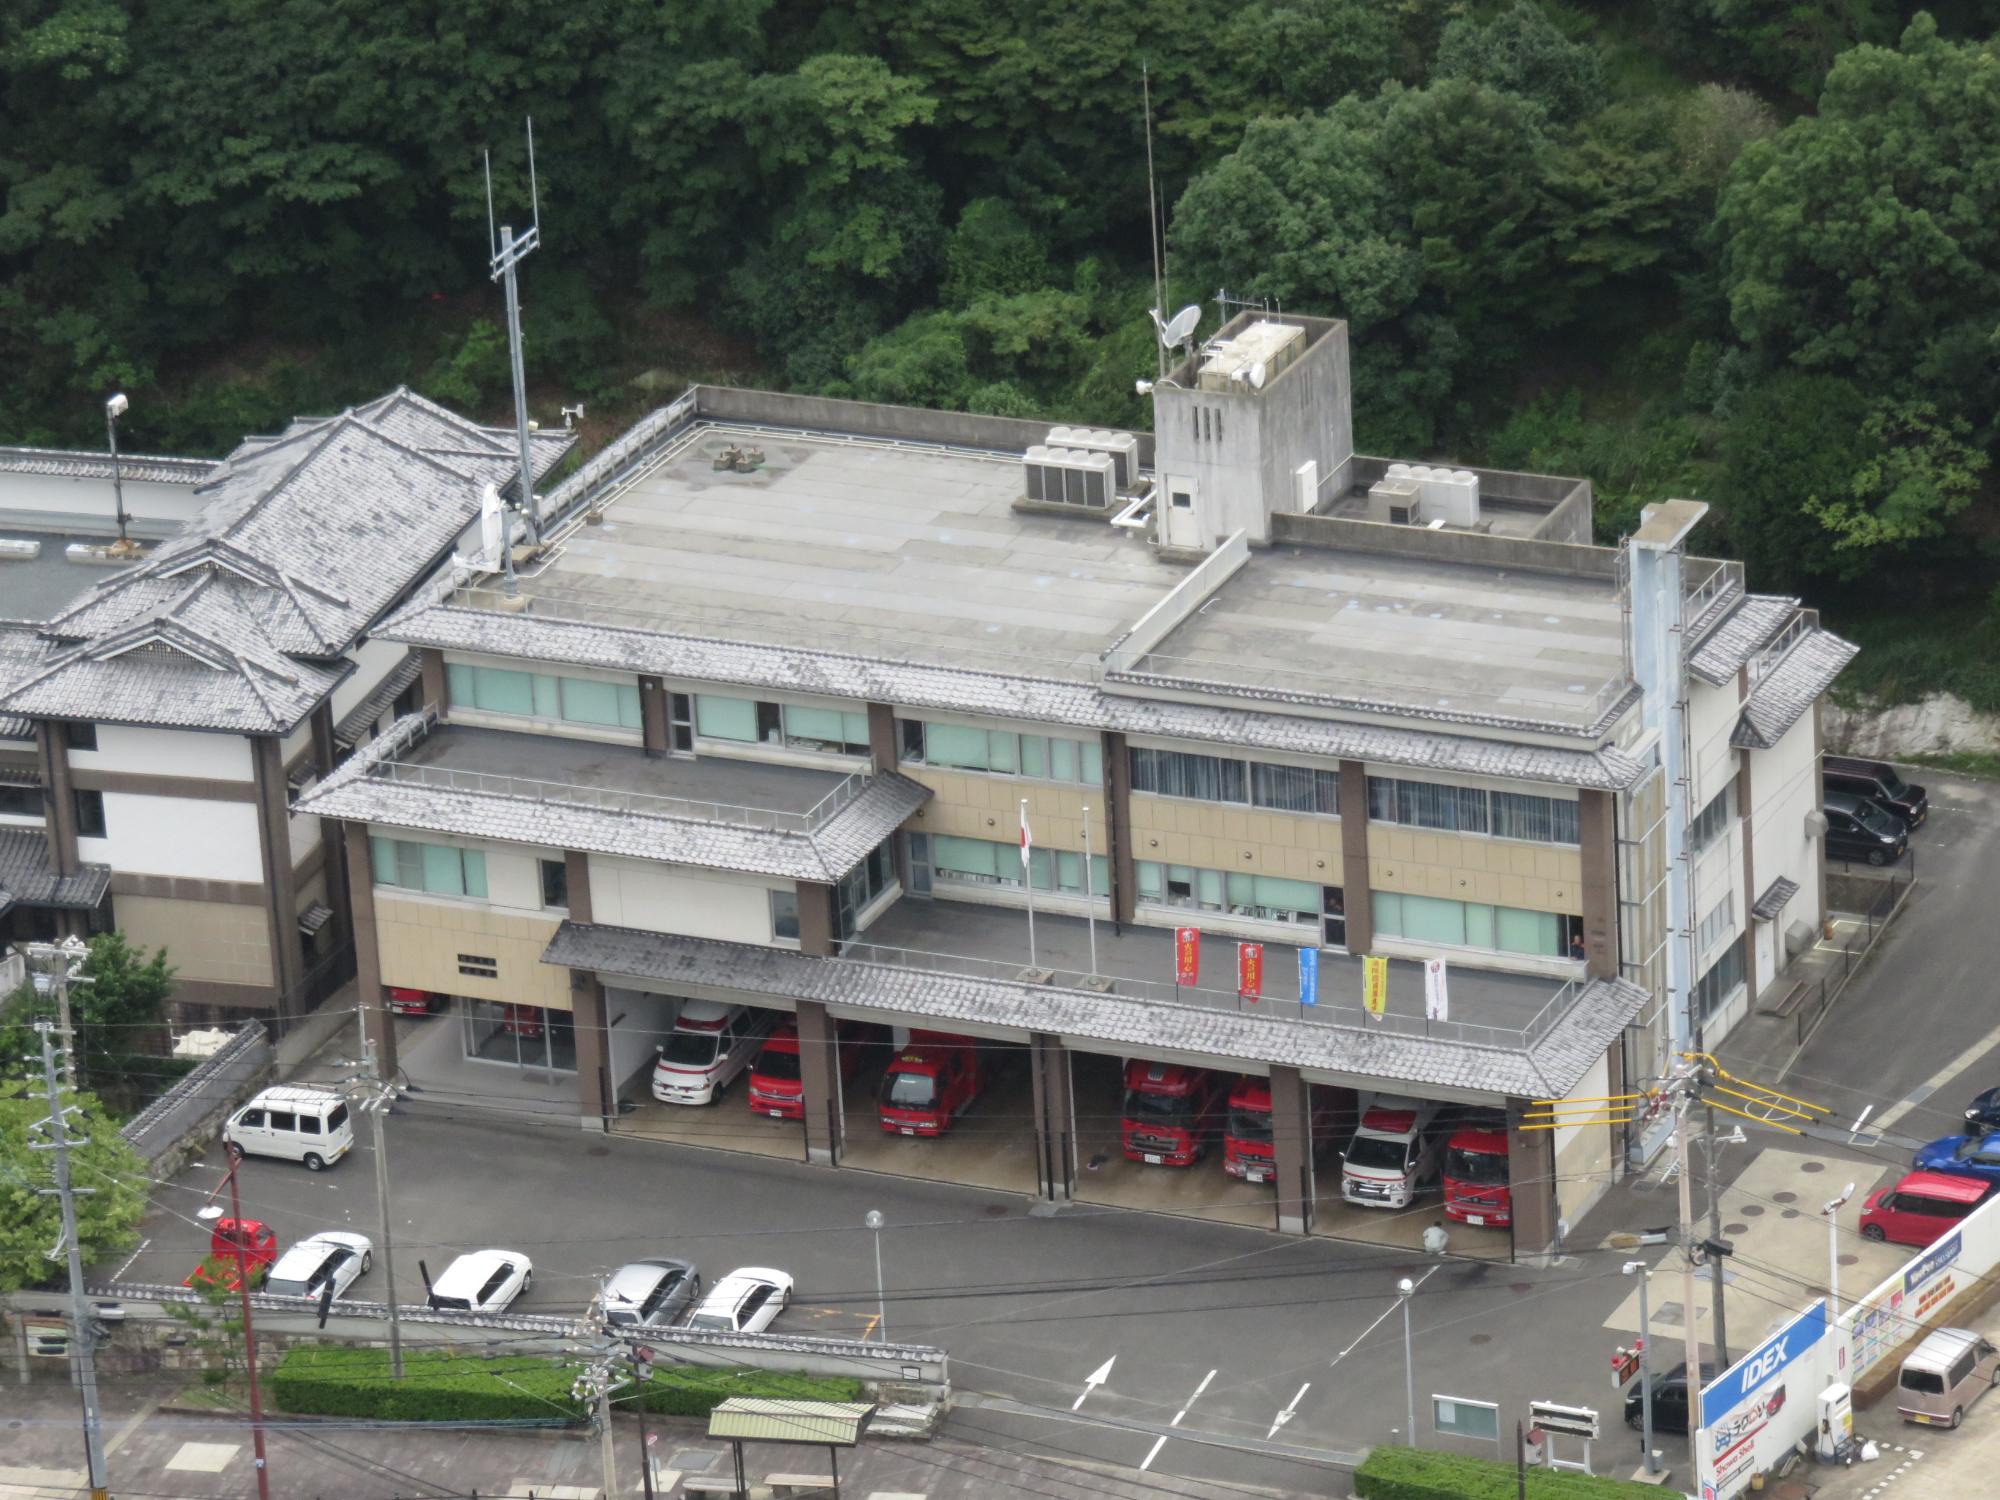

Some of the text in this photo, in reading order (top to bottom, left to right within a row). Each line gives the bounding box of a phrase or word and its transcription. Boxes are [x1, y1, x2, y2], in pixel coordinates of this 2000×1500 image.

[1741, 1335, 1789, 1394] IDEX
[1716, 1456, 1738, 1475] Showa
[1739, 1439, 1754, 1458] Shell
